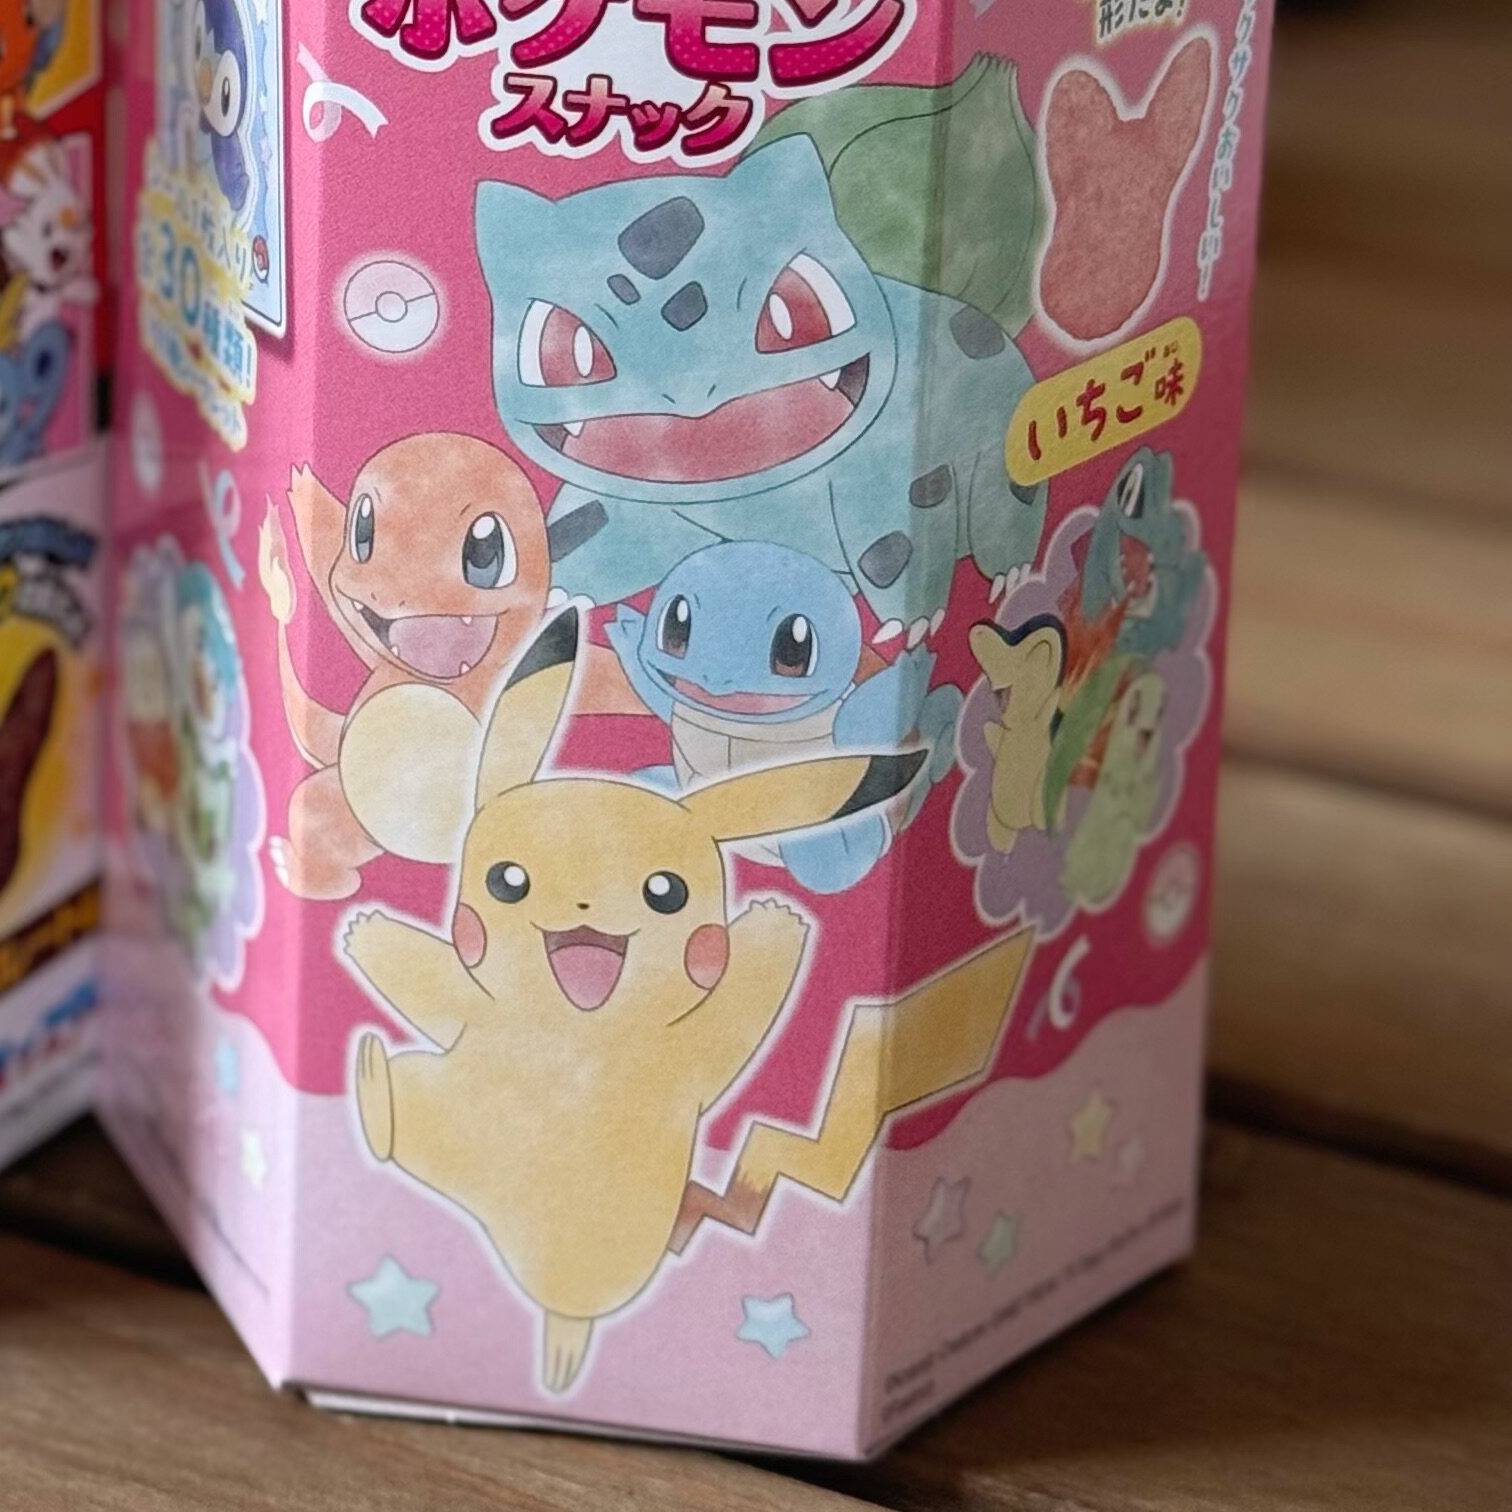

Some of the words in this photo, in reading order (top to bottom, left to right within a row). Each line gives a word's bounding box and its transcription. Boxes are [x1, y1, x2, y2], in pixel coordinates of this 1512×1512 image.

[491, 72, 755, 156] スナック
[1027, 348, 1185, 461] いちご味
